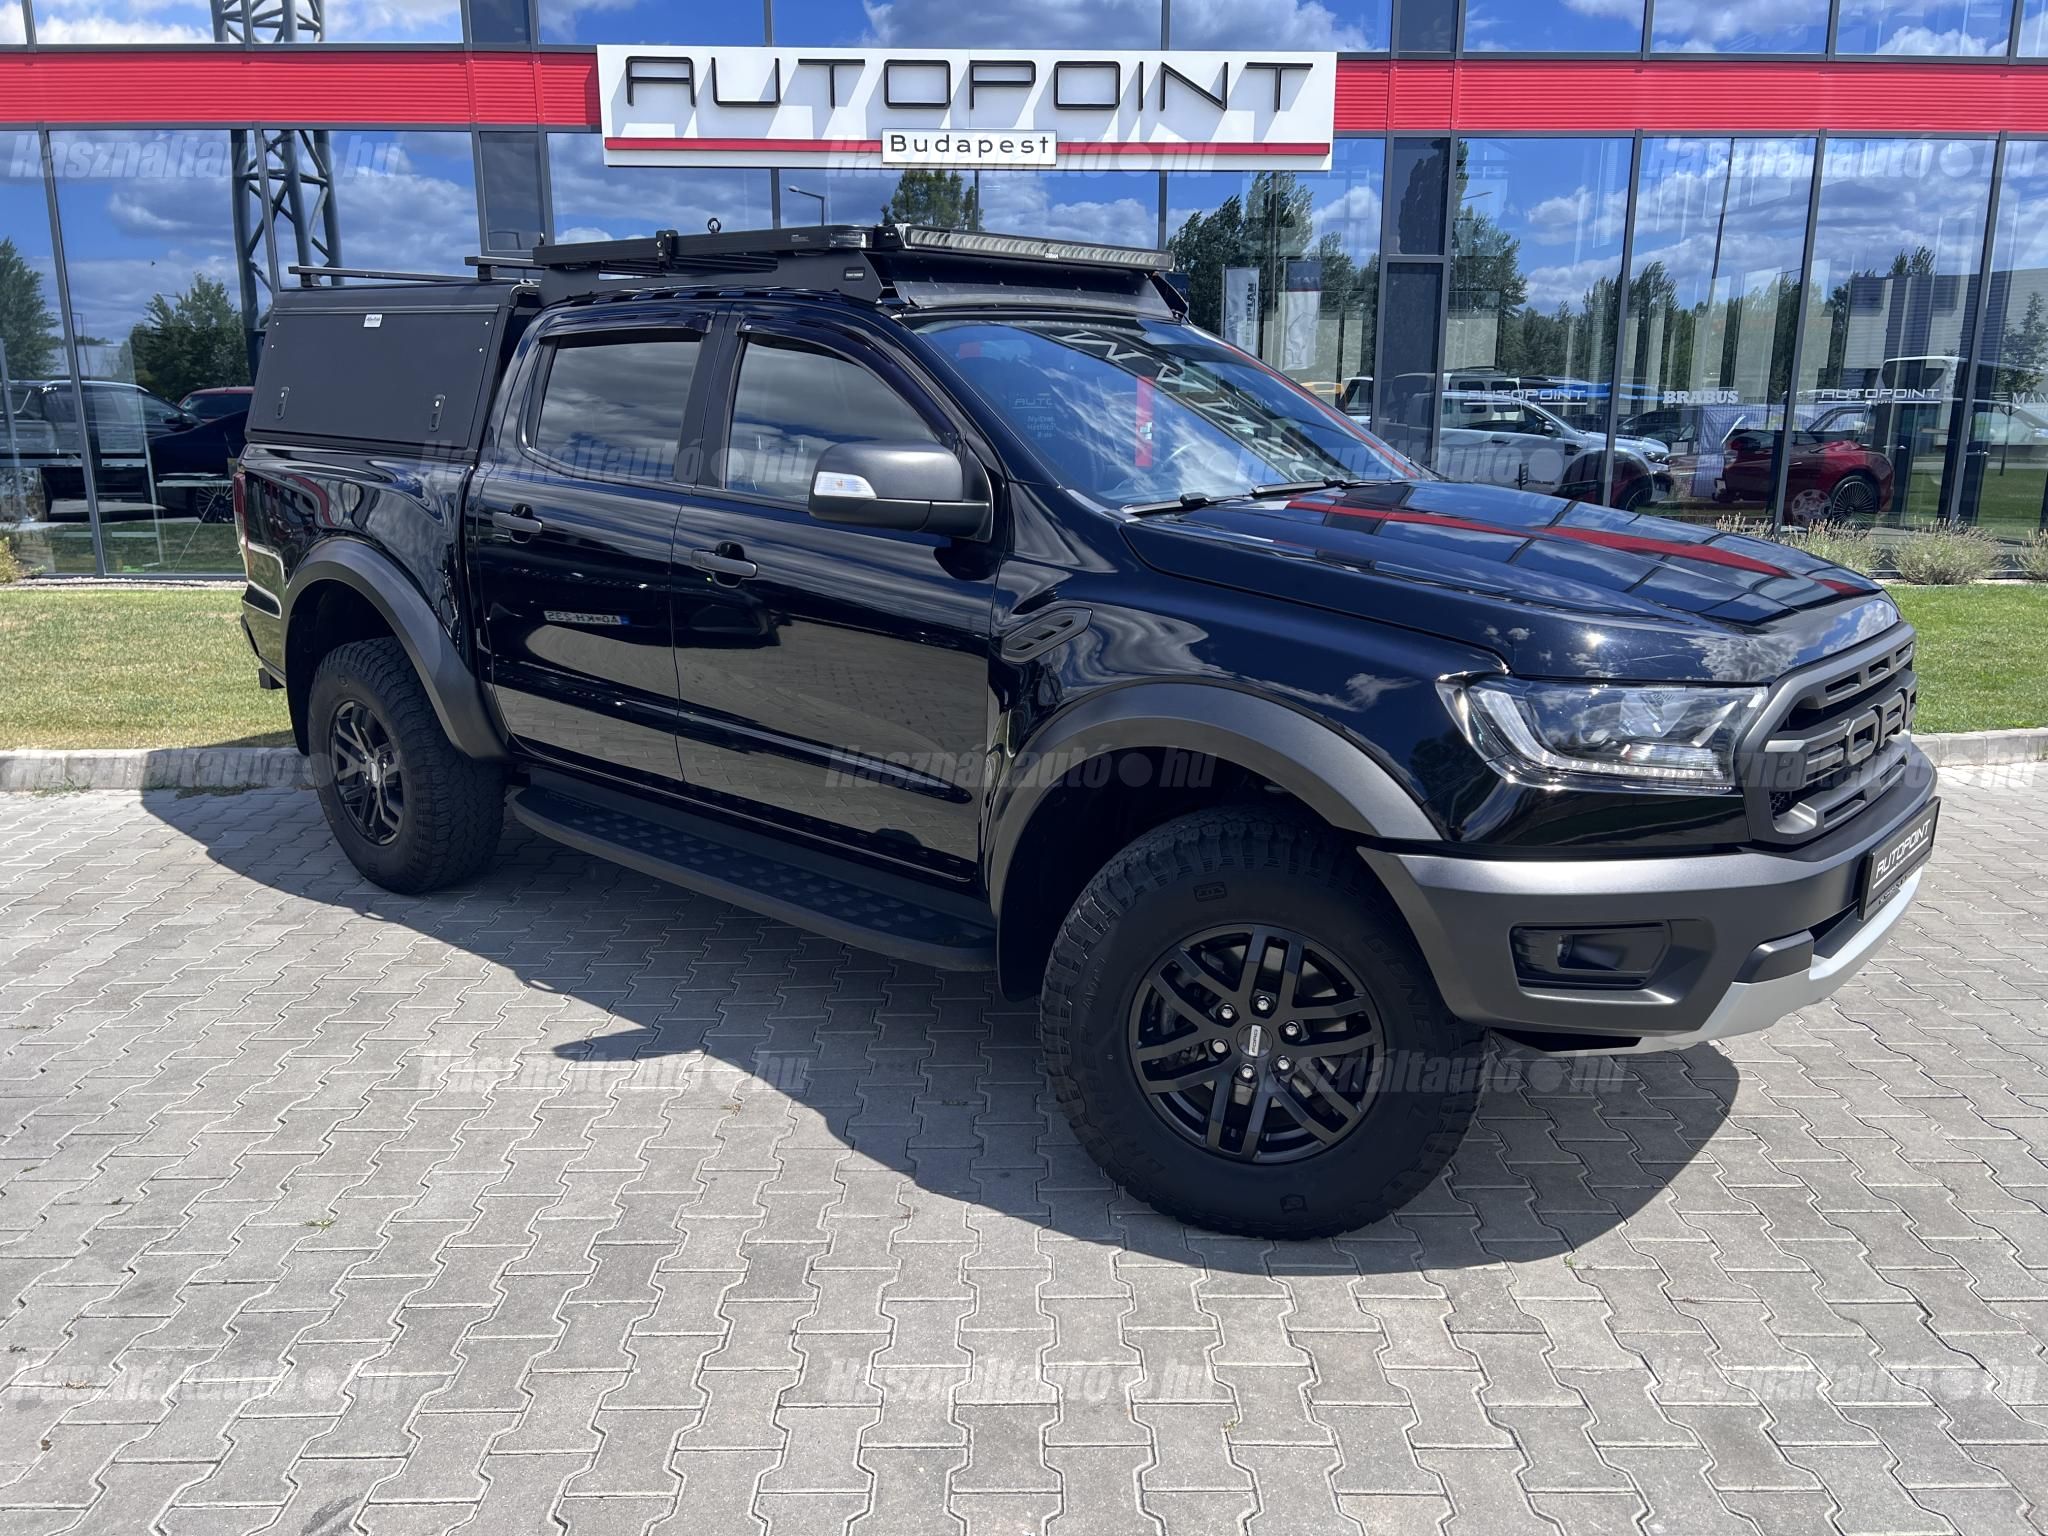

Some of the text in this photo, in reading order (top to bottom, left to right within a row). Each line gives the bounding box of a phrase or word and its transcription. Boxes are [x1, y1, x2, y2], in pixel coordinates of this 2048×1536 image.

[625, 55, 1314, 112] AUTOPOINT
[890, 134, 1050, 158] Budapest
[1468, 390, 1586, 400] AUTOPOINT
[1663, 390, 1740, 404] BRABUS
[1821, 388, 1941, 399] AUTOPOINT
[1875, 818, 1931, 880] AUTOPOINT
